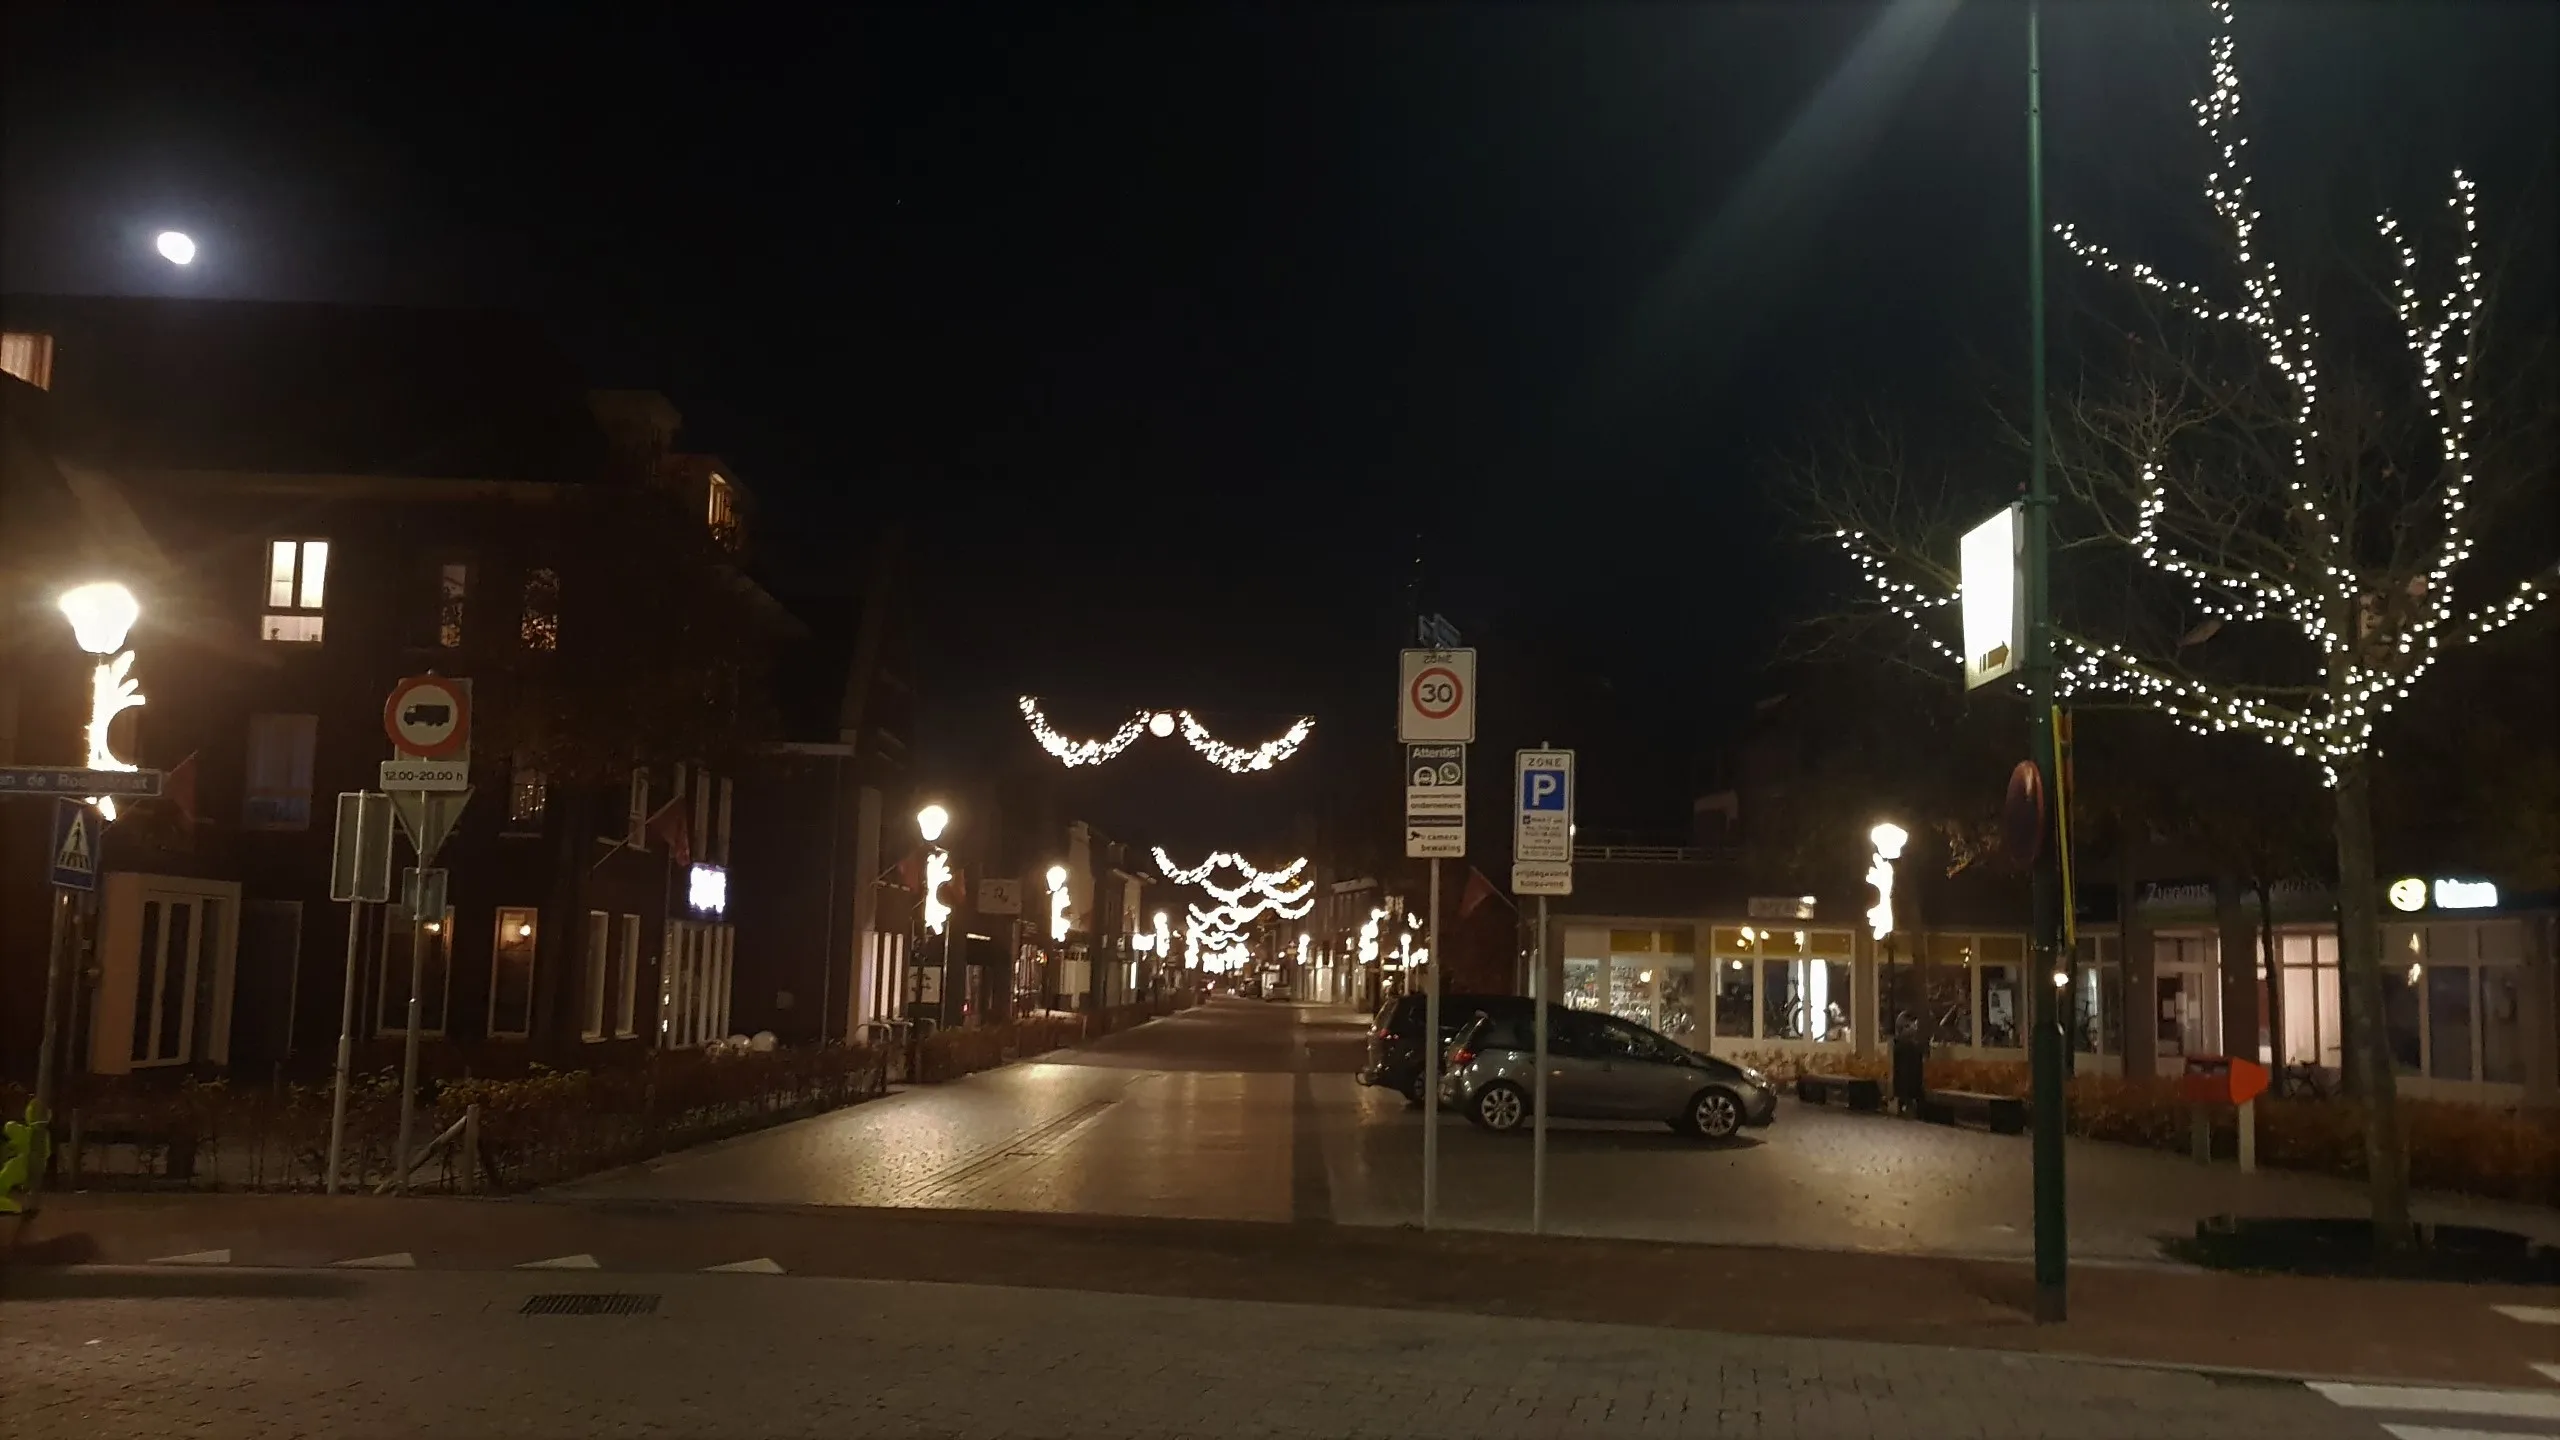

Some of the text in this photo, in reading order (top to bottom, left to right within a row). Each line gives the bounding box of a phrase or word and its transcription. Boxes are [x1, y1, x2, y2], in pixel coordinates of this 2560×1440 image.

[1421, 683, 1453, 703] 30
[1412, 747, 1460, 759] Attentie!
[1528, 757, 1562, 767] ZONE
[27, 773, 47, 787] de
[456, 772, 464, 781] h
[1532, 773, 1557, 806] P
